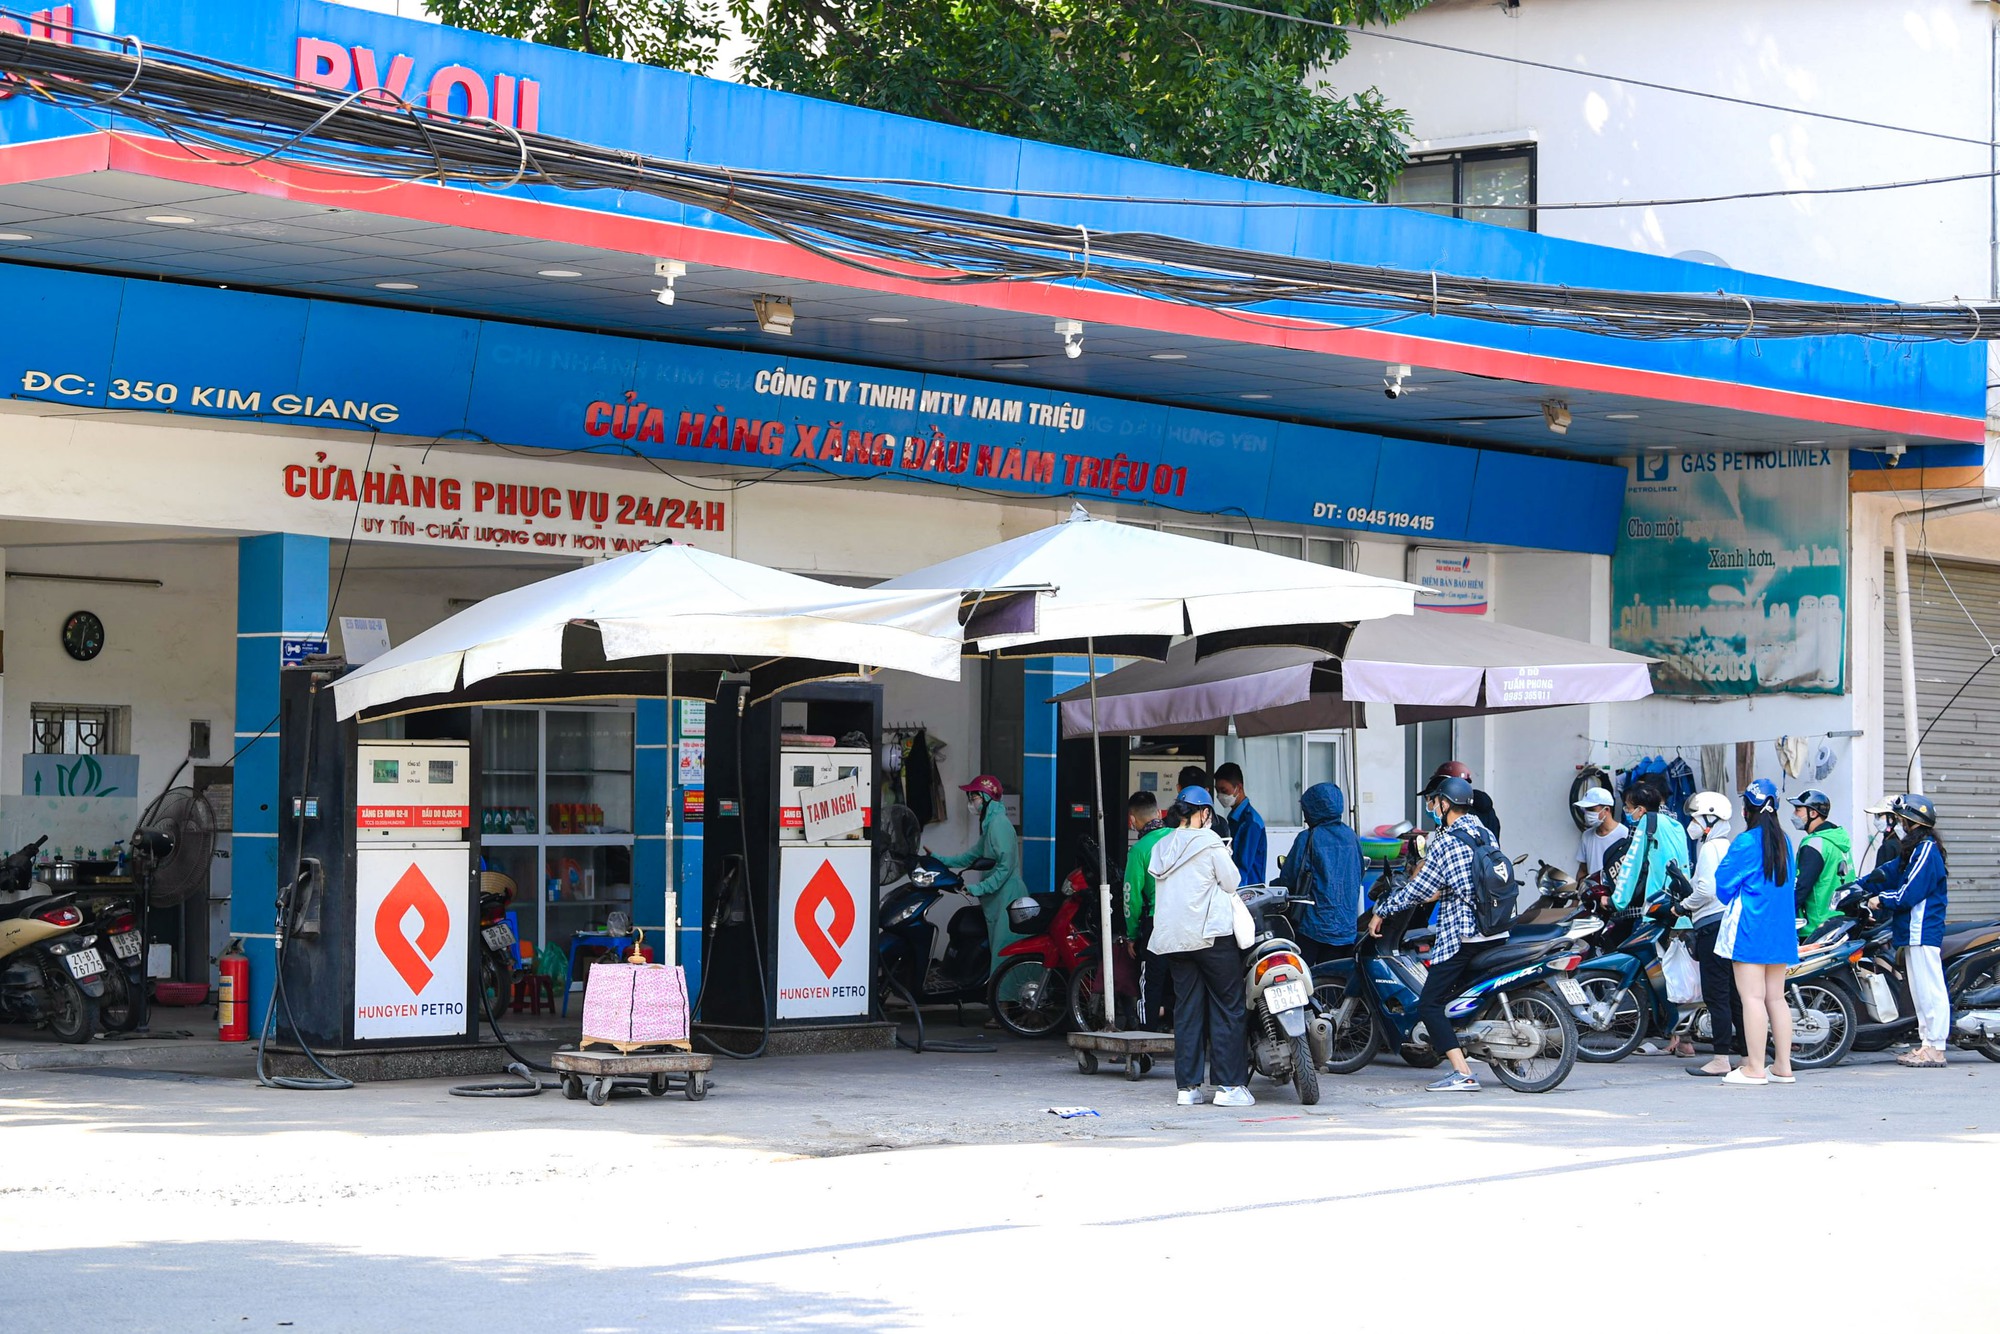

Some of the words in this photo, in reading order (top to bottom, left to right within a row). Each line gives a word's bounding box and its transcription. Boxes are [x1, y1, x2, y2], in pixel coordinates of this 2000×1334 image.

[295, 37, 414, 112] PV
[21, 370, 95, 397] ĐC:
[108, 378, 178, 405] 350
[190, 386, 262, 412] KIM
[271, 393, 400, 424] GIANG
[754, 366, 817, 399] CÔNG
[824, 377, 851, 403] TY
[858, 382, 915, 411] TNHH
[919, 390, 967, 416] MTV
[971, 396, 1022, 423] NAM
[1028, 401, 1086, 433] TRIỆU
[584, 390, 665, 444] CỬA
[676, 404, 785, 456] HÀNG
[792, 420, 896, 468] XĂNG
[901, 423, 971, 474] DẦU
[975, 444, 1055, 484] NAM
[1062, 453, 1150, 497] TRIỆU
[1153, 463, 1188, 497] 01
[1681, 451, 1717, 473] GAS
[1723, 448, 1831, 471] PETROLIMEX
[283, 451, 358, 503] CỬA
[360, 464, 462, 511] HÀNG
[472, 480, 562, 525] PHỤC
[567, 489, 610, 529] VỤ
[616, 494, 726, 532] 24/24H
[1313, 502, 1342, 519] ĐT:
[361, 517, 384, 534] UY
[389, 514, 415, 537] TÍN
[424, 517, 469, 541] CHẤT
[1627, 518, 1652, 537] Cho
[1655, 517, 1681, 543] một
[1708, 548, 1744, 568] Xanh
[1747, 548, 1776, 569] hơn,
[1526, 679, 1553, 689] PHONG
[806, 800, 830, 825] TẠM
[831, 785, 857, 816] NGHỈ
[1615, 828, 1644, 903] BAEMIN
[1123, 881, 1131, 919] Grab
[72, 950, 96, 966] 21-B1
[780, 986, 830, 1000] HUNGYEN
[832, 985, 866, 998] PETRO
[1271, 984, 1299, 999] 30-N4
[358, 1004, 418, 1019] HUNGYEN
[421, 1002, 464, 1016] PETRO
